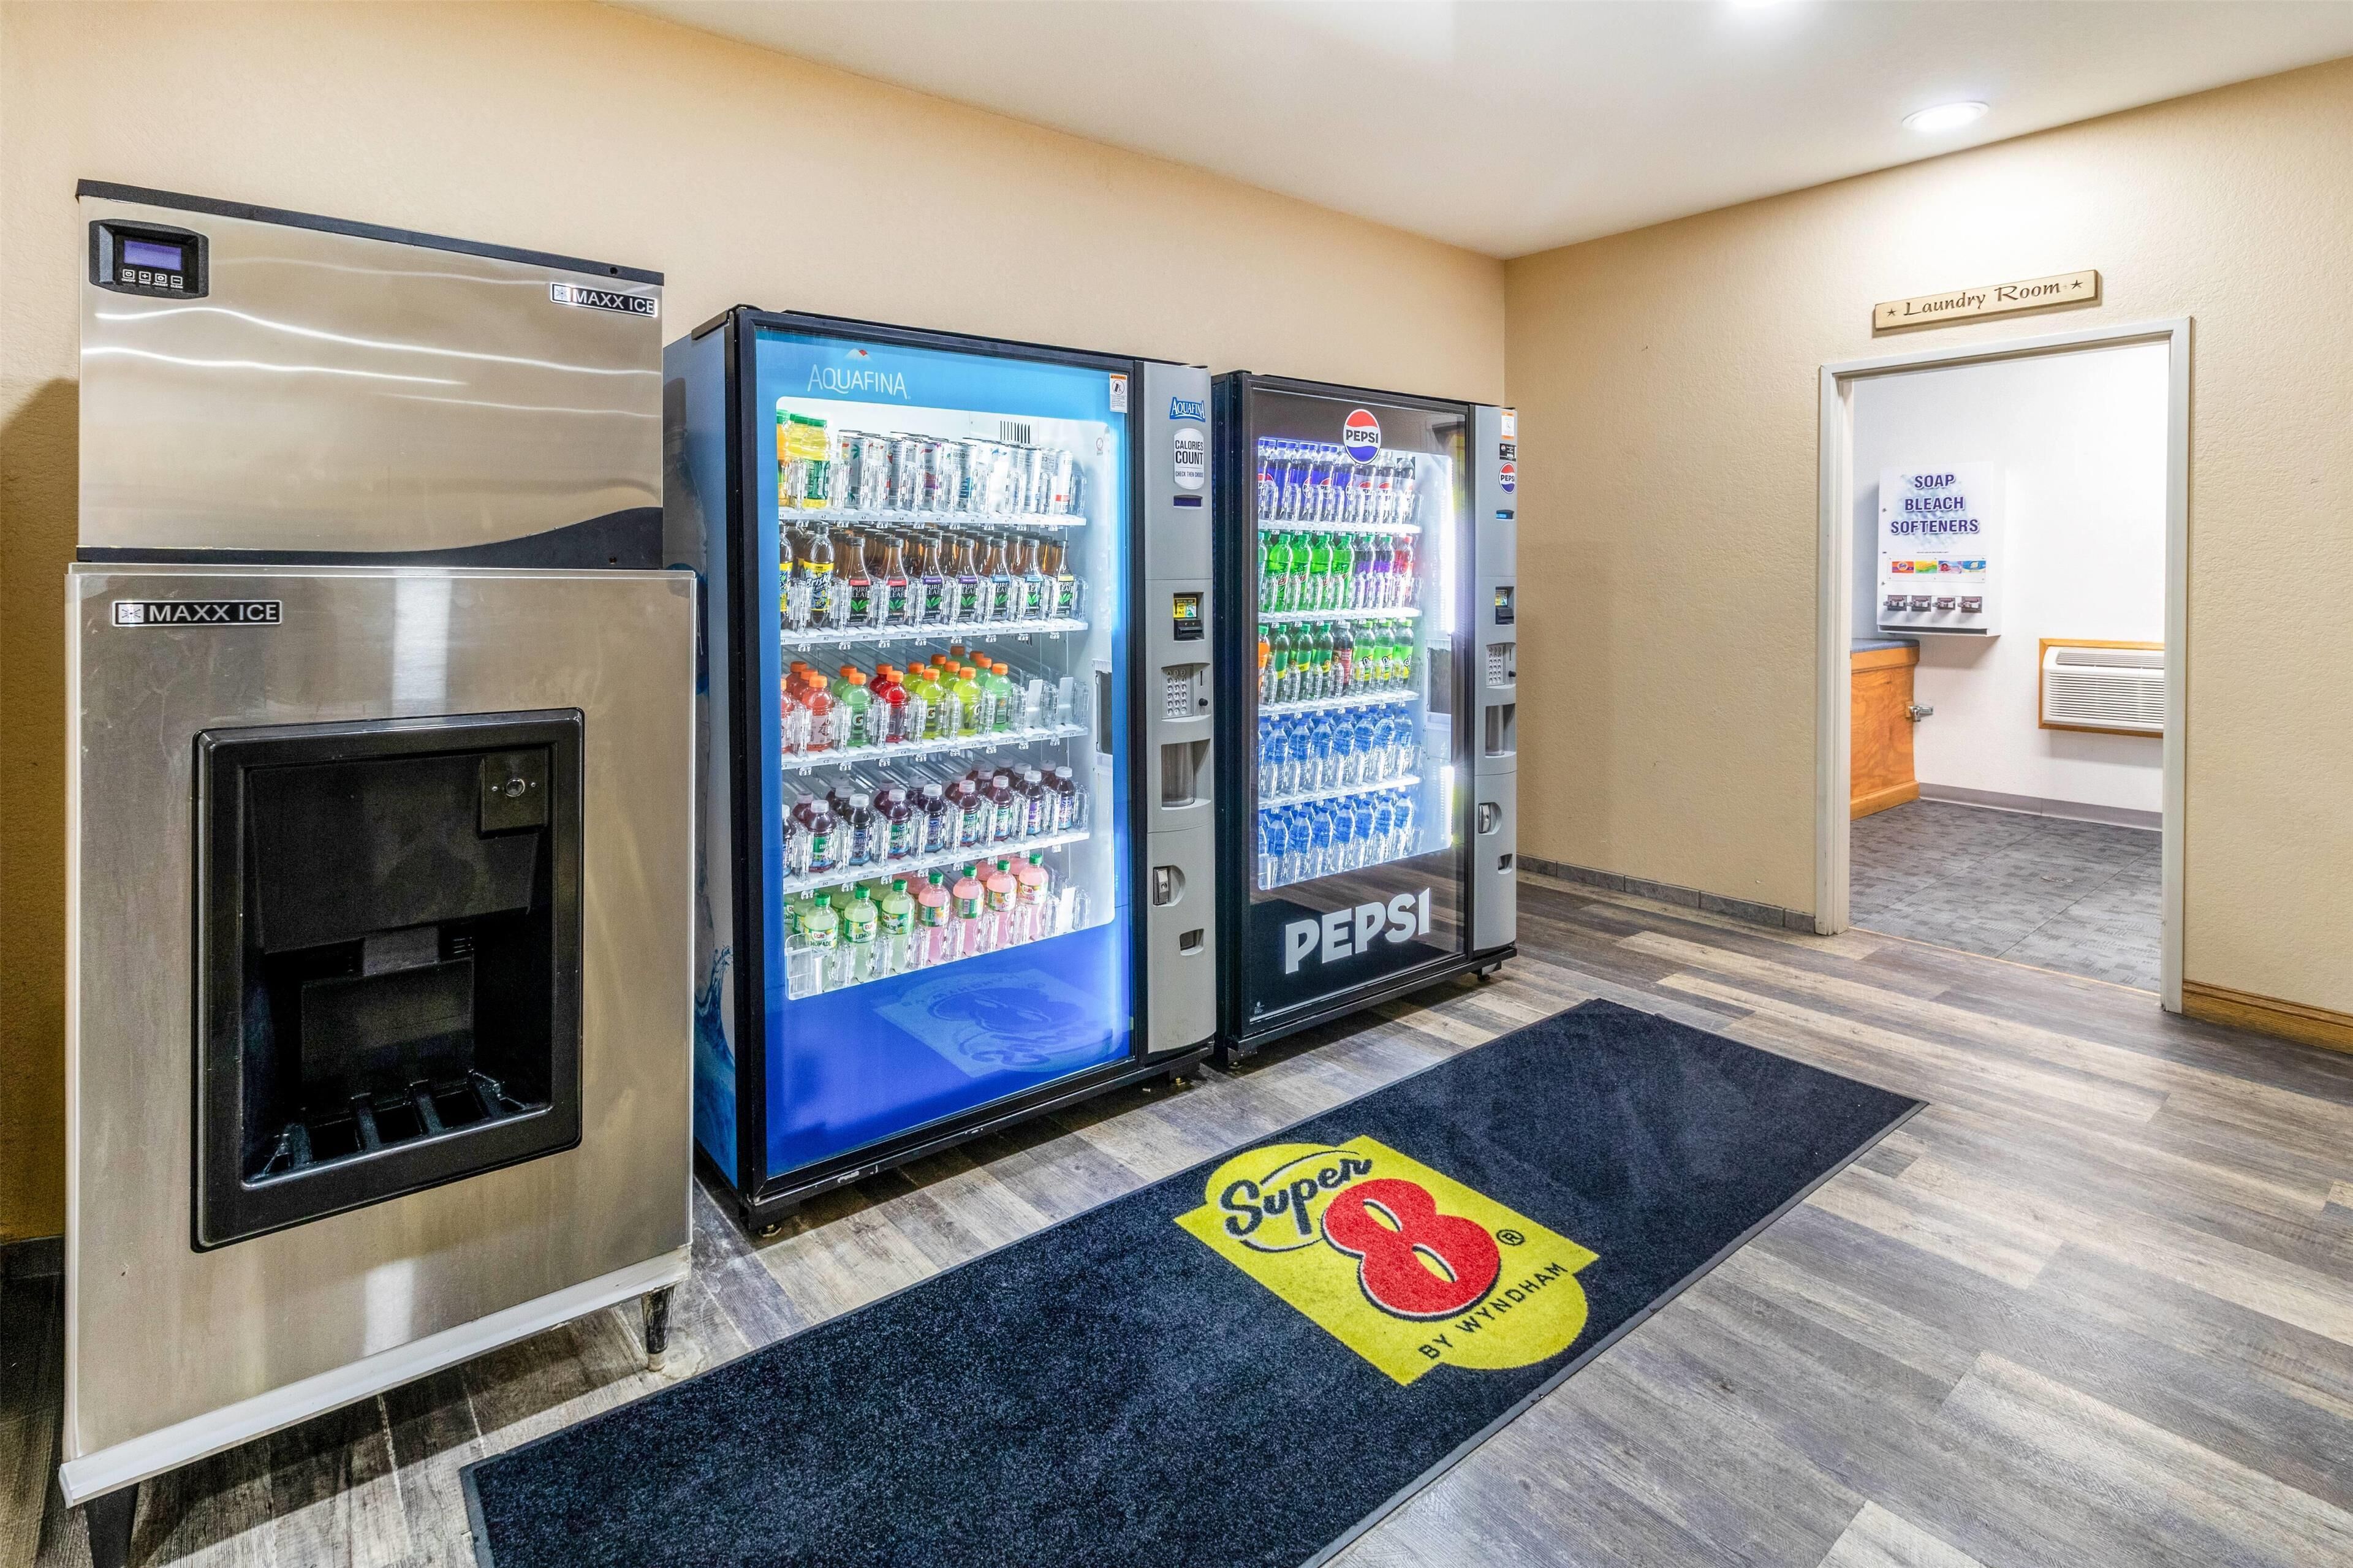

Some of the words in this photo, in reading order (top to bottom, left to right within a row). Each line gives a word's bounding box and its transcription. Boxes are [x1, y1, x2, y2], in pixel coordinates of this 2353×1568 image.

[572, 288, 624, 309] MAXX
[629, 298, 654, 313] ICE
[1903, 292, 1985, 316] Laundry
[1993, 282, 2060, 302] Room
[807, 364, 908, 400] AQUAFINA
[1171, 398, 1205, 419] AQUAFINA
[1175, 440, 1203, 451] CALORIES
[1346, 429, 1379, 444] PEPSI
[1175, 451, 1203, 465] COUNT
[1914, 474, 1955, 488] SOAP
[1904, 496, 1964, 511] BLEACH
[1891, 520, 1979, 534] SOFTENERS
[149, 604, 230, 621] MAXX
[239, 604, 278, 621] ICE
[1286, 887, 1430, 975] PEPSI
[1219, 1156, 1373, 1241] Super
[1320, 1177, 1501, 1323] 8
[1418, 1334, 1455, 1360] BY
[1455, 1261, 1569, 1334] WYNDHAM
